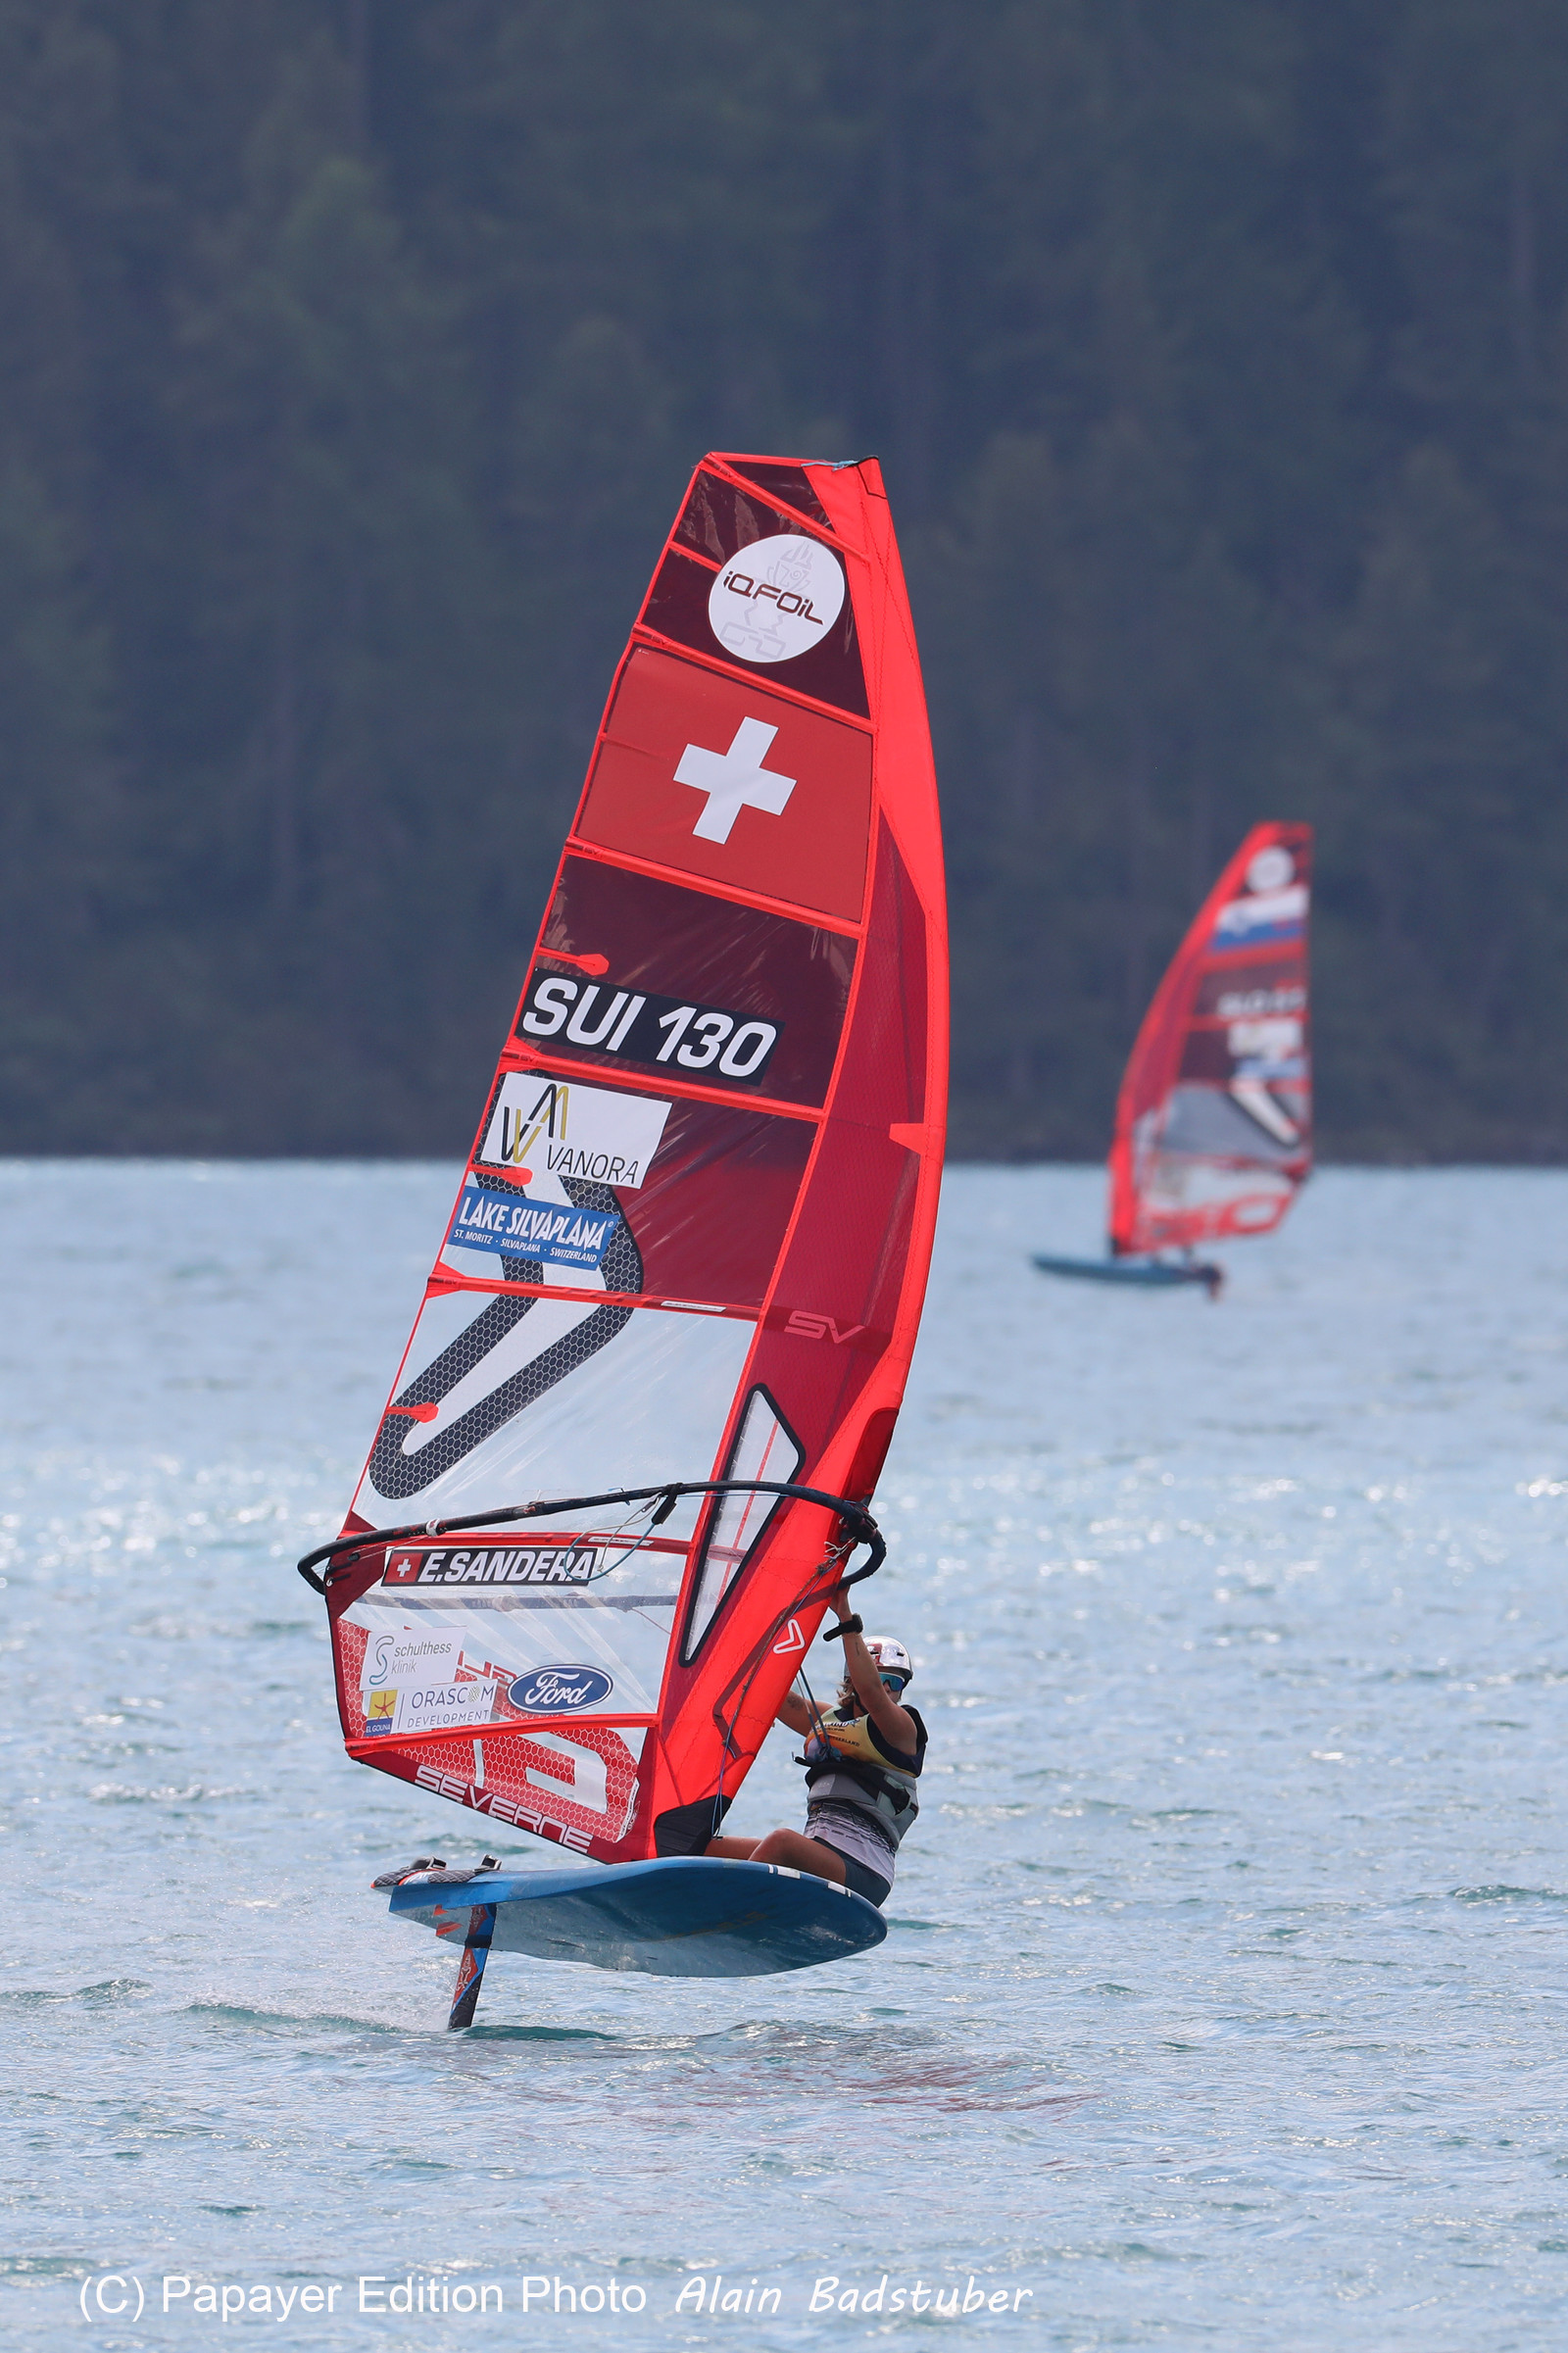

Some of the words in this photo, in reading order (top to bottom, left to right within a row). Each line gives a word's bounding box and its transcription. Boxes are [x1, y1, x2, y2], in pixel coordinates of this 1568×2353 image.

[522, 977, 647, 1052] SUI
[656, 1006, 777, 1078] 130
[546, 1144, 640, 1184] VANORA
[458, 1196, 510, 1233] LAKE
[506, 1206, 607, 1250] SILVAPLANA
[454, 1228, 465, 1240] ST.
[465, 1231, 494, 1245] MORITZ
[500, 1238, 541, 1253] SILVAPLANA
[550, 1247, 598, 1263] SWITZERLAND
[417, 1550, 595, 1583] E.SANDERA
[394, 1641, 453, 1657] schulthess
[391, 1658, 417, 1675] klinik
[524, 1671, 594, 1705] Ford
[407, 1709, 490, 1728] DEVELOPMENT
[415, 1764, 594, 1854] SEVERNE
